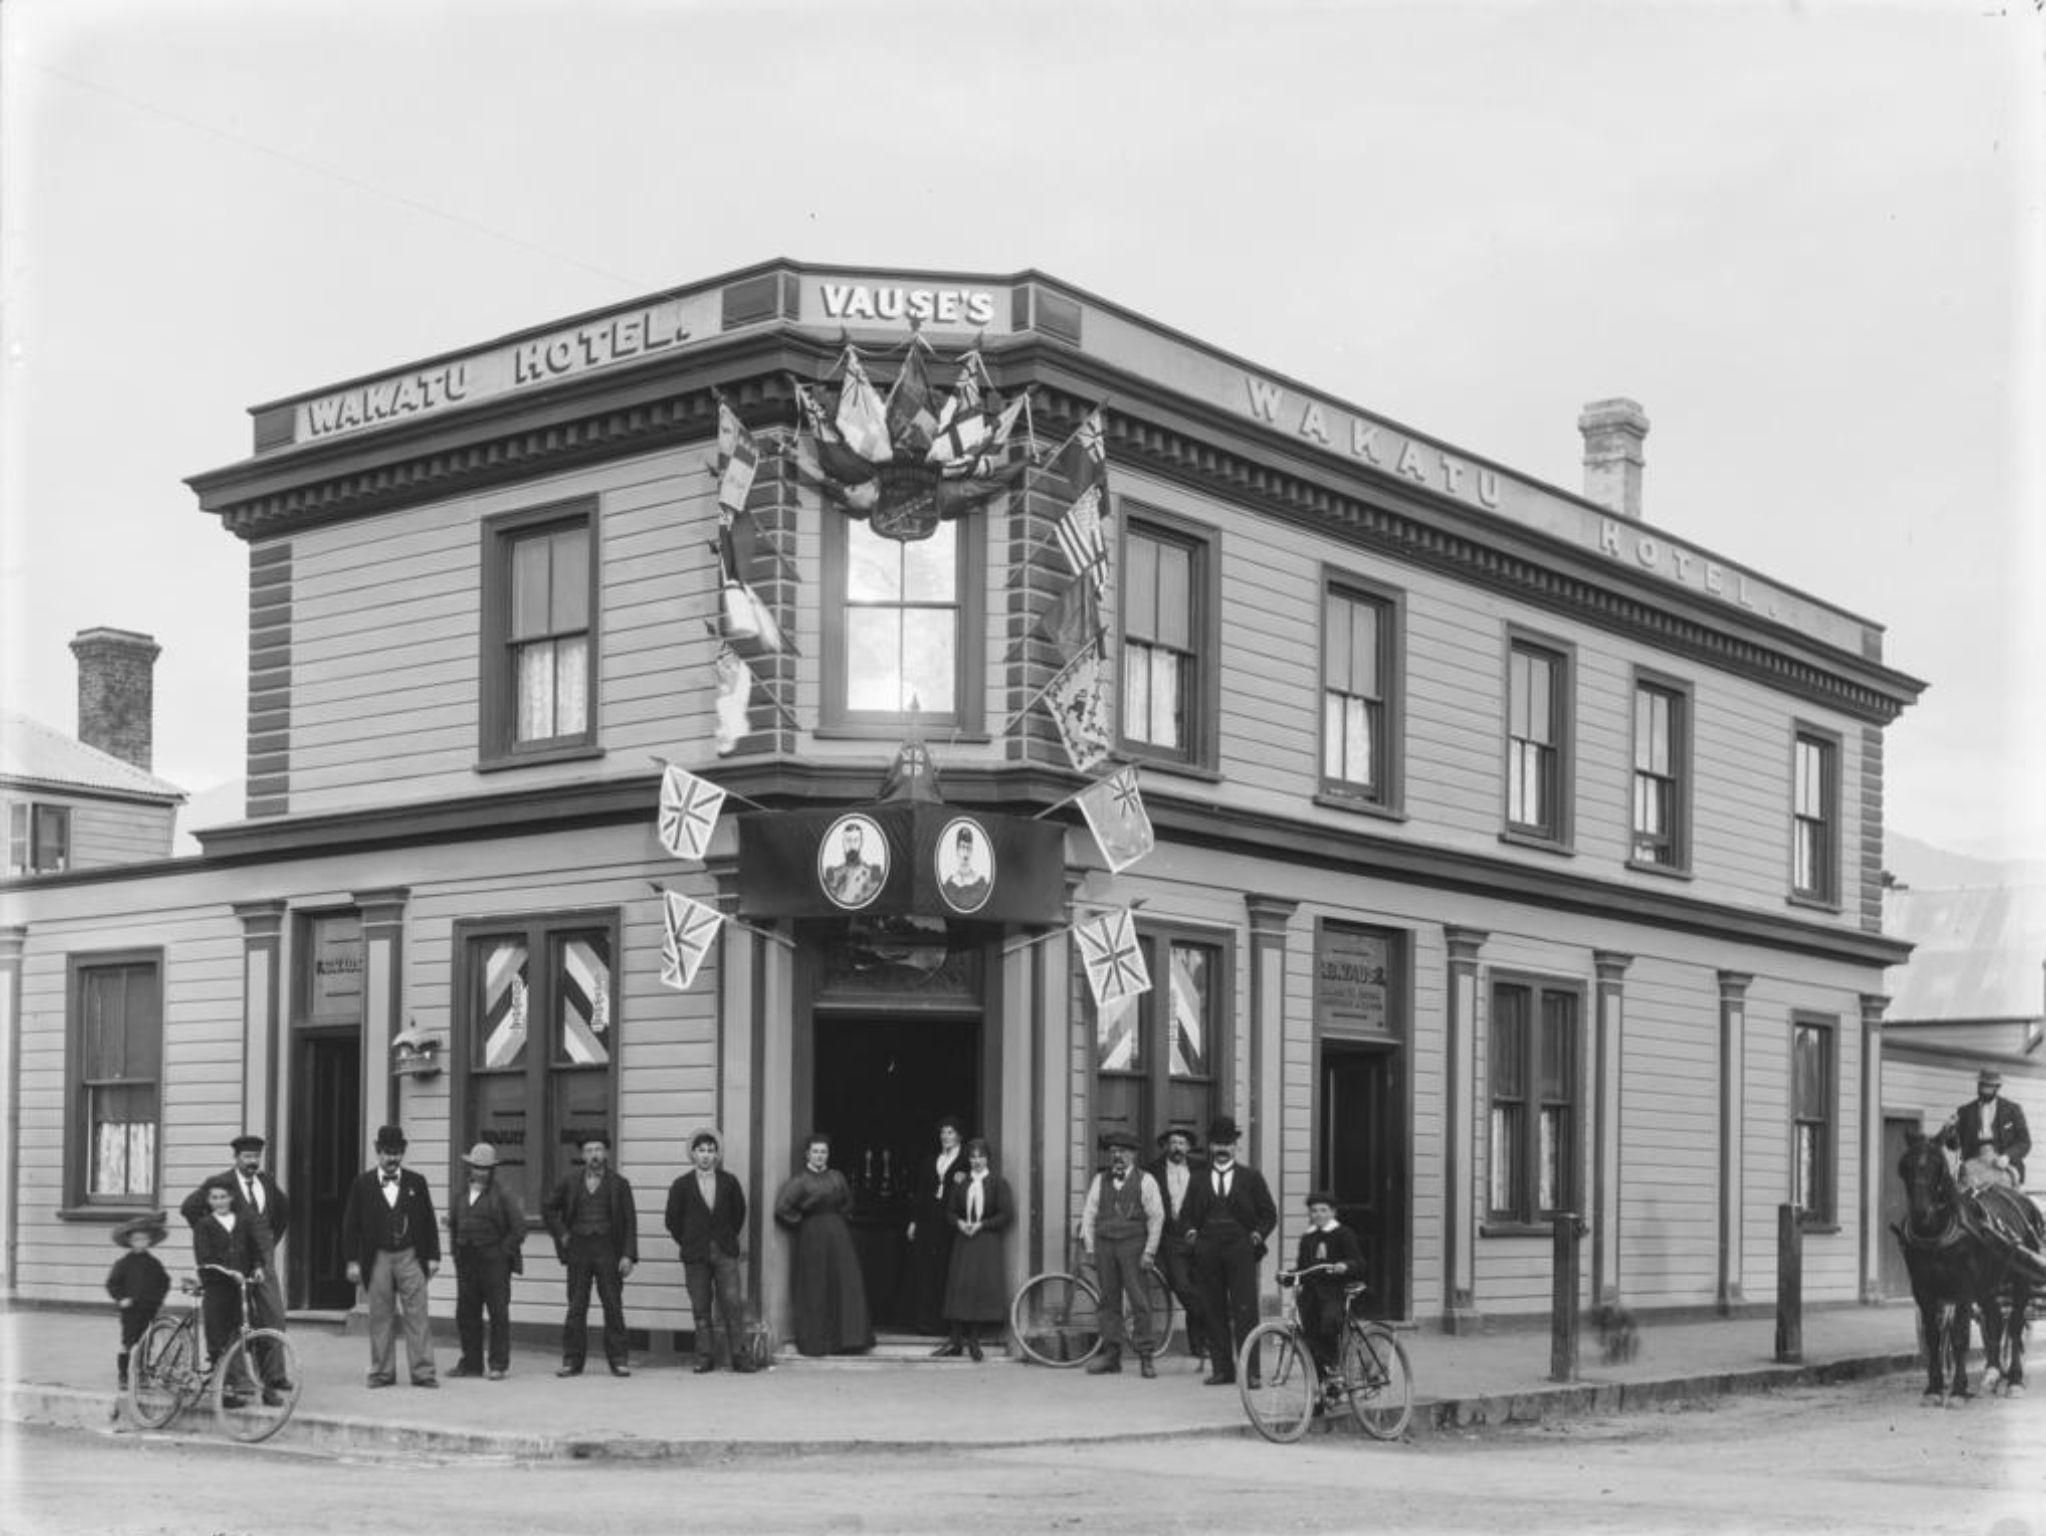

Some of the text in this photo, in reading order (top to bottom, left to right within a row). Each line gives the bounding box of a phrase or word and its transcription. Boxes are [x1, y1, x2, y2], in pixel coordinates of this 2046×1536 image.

[820, 283, 995, 327] VAUSE'S
[307, 311, 692, 436] WAKATU HOTEL.
[1245, 376, 1499, 510] WAKATU
